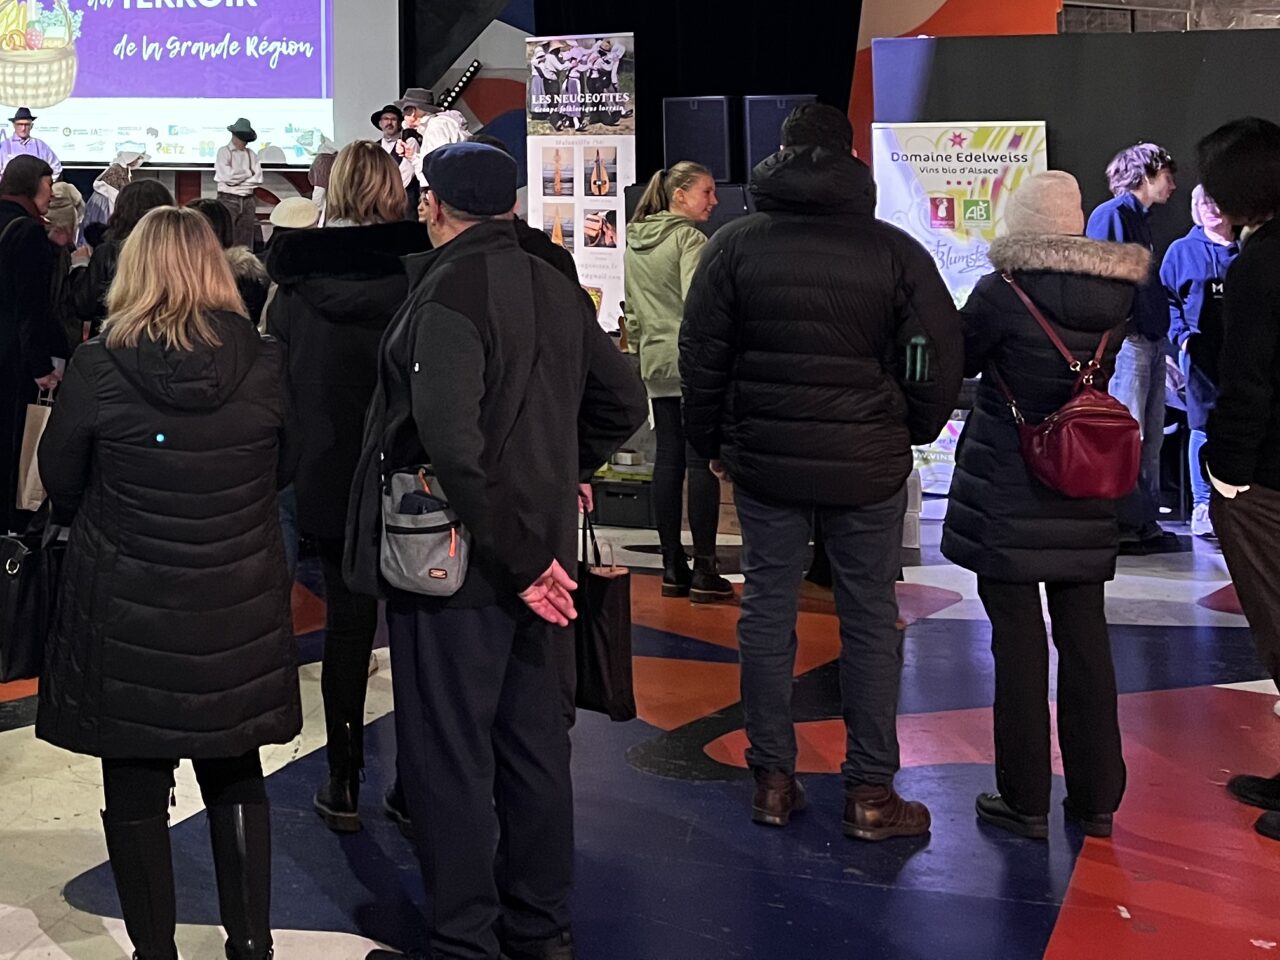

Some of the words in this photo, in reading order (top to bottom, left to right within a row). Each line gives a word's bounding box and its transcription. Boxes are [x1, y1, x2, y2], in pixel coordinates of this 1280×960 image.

[113, 34, 138, 60] de
[142, 32, 162, 61] la
[165, 35, 241, 60] Grande
[245, 34, 314, 70] Région
[531, 94, 552, 104] LES
[553, 92, 630, 104] NEUGEOTTES
[891, 151, 952, 163] Domaine
[956, 151, 1028, 163] Edelweiss
[919, 166, 940, 174] Vins
[942, 166, 958, 174] bio
[959, 166, 999, 174] d'Alsace
[965, 204, 987, 220] AB
